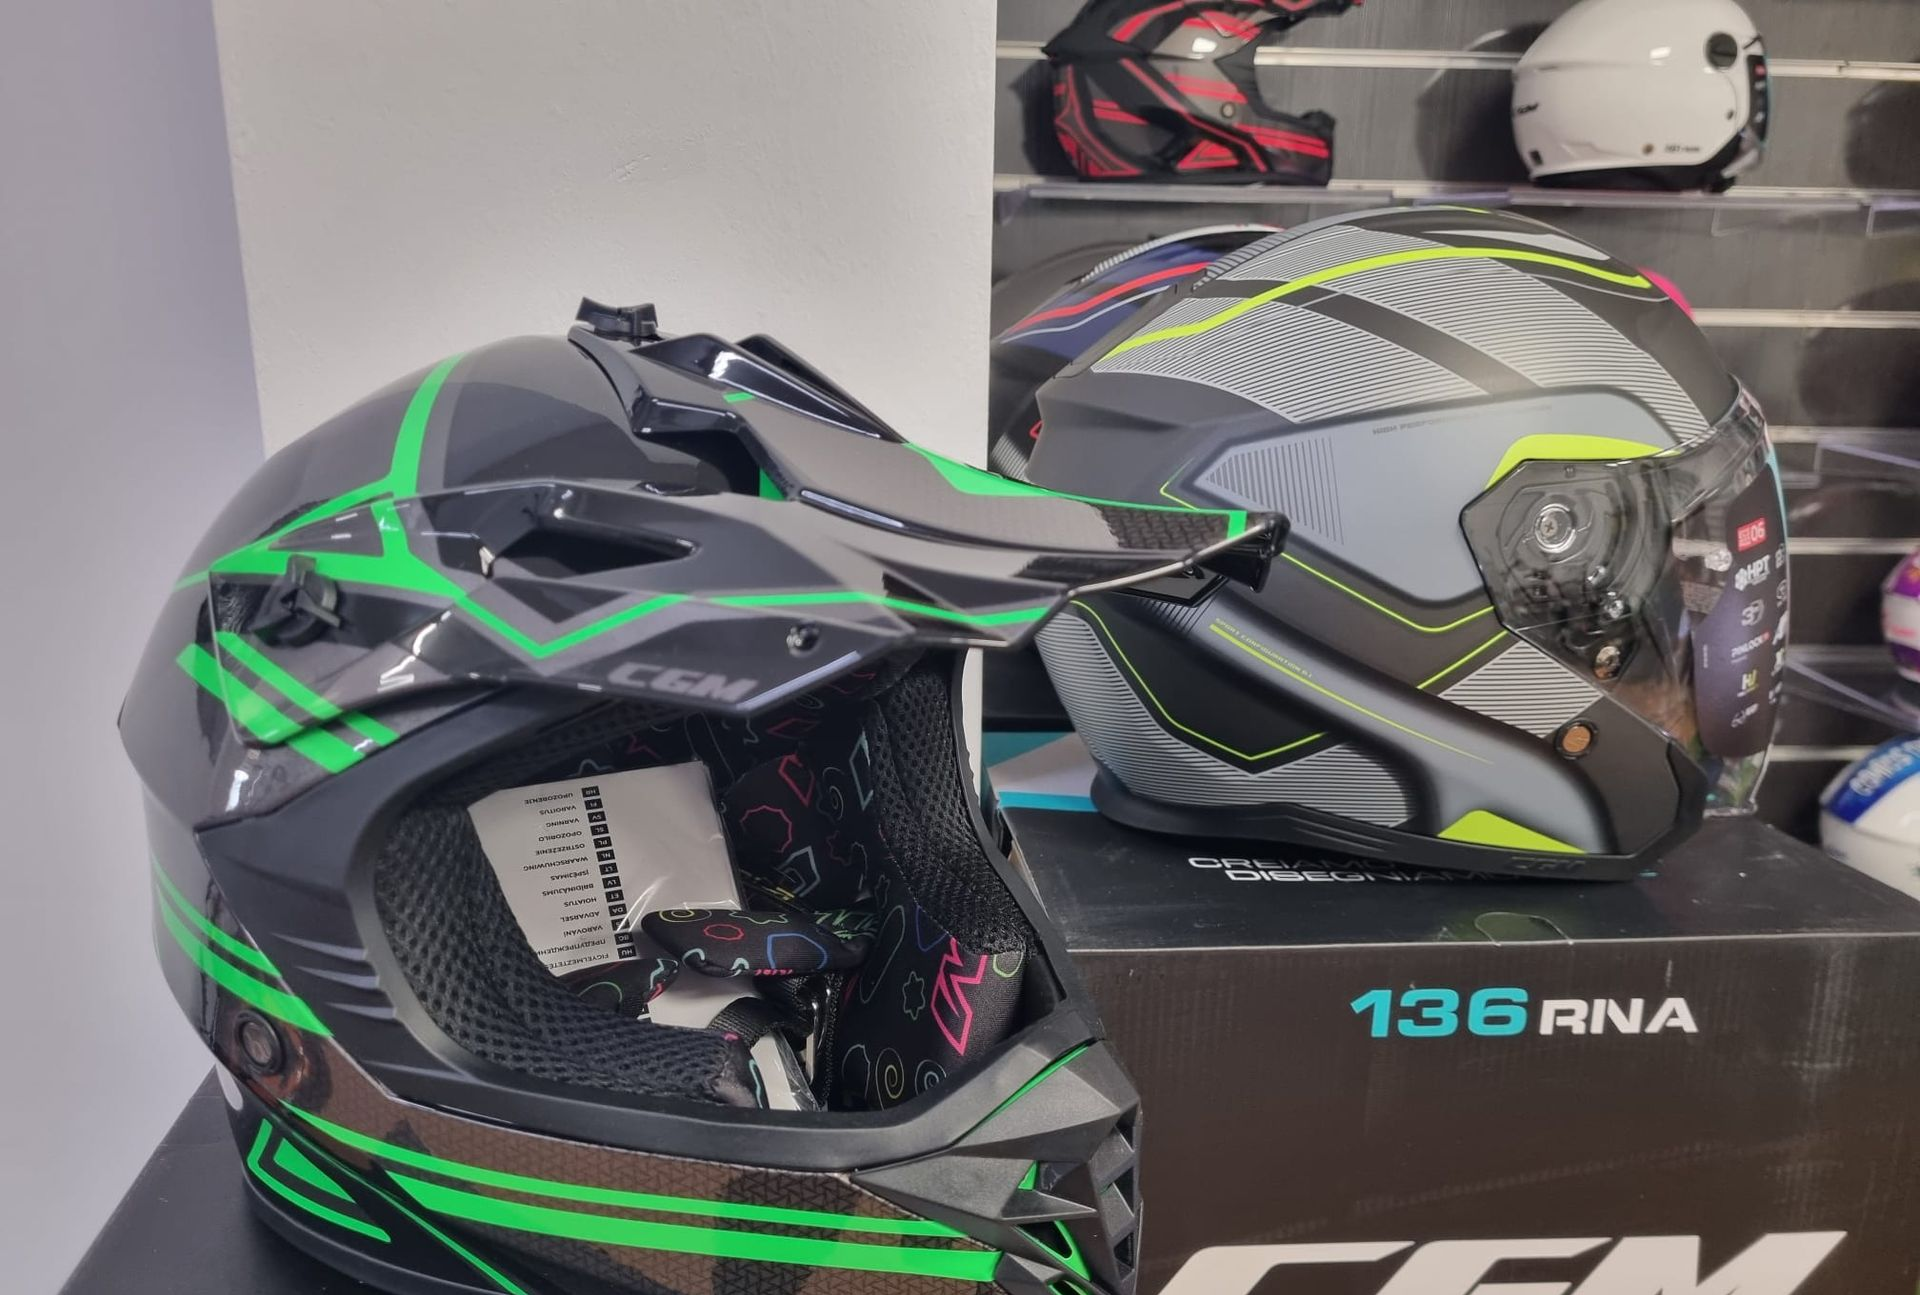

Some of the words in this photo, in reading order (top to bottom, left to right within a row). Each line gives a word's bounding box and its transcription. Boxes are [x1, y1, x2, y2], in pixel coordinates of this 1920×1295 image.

[1747, 555, 1770, 581] HPT
[607, 661, 759, 702] CGM
[545, 818, 580, 828] VARNING
[538, 830, 582, 842] OPOZORILO
[523, 856, 589, 871] WAARSCHUWING
[564, 897, 597, 907] HOIATUS
[560, 911, 600, 923] ADVARSEL
[1350, 987, 1529, 1038] 136
[1539, 997, 1699, 1035] RNA
